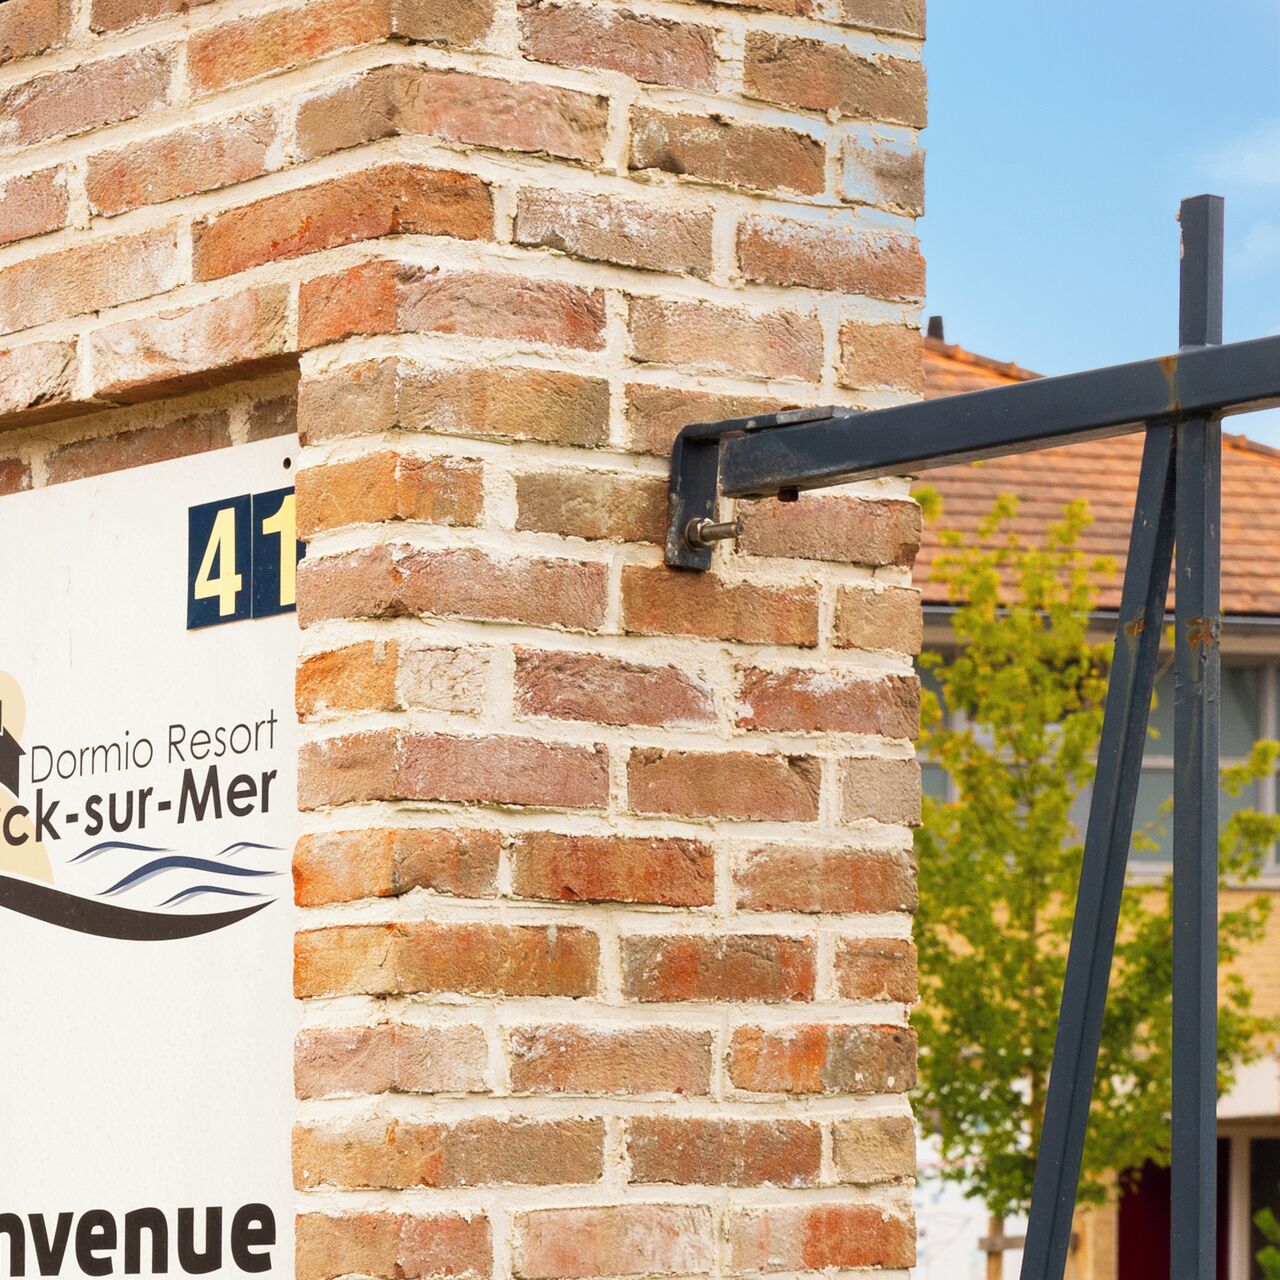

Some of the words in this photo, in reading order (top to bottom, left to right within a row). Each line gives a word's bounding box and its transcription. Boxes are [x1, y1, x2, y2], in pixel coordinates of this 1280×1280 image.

[194, 494, 297, 617] 41
[30, 730, 153, 784] Dormio
[168, 708, 278, 764] Resort
